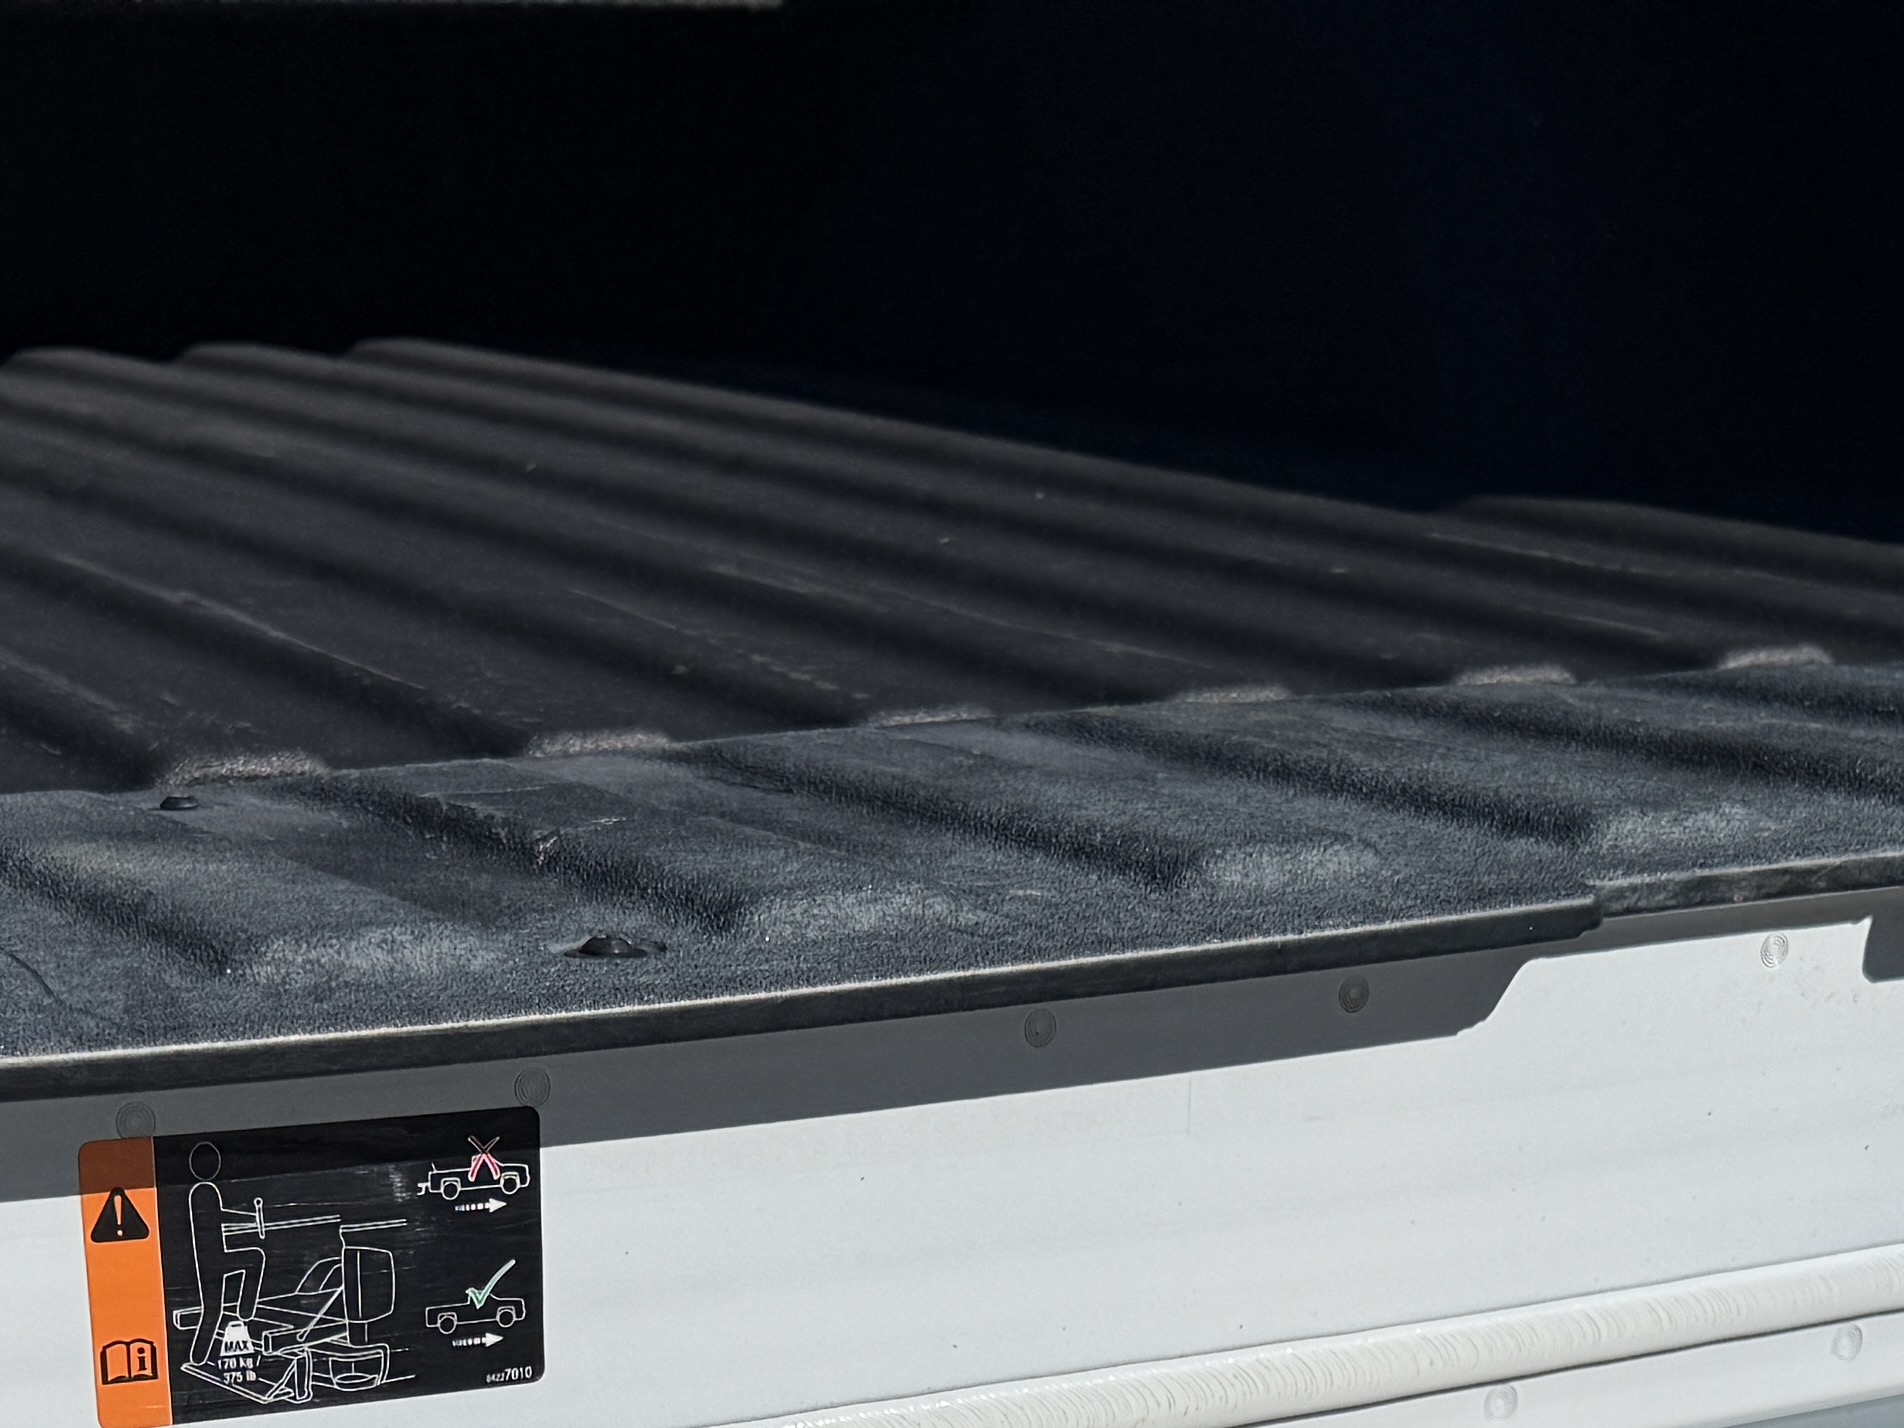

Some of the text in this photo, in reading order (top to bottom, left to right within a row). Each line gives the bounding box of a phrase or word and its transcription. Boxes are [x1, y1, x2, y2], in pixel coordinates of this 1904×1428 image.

[224, 1340, 250, 1353] MAX
[217, 1357, 237, 1370] 170
[223, 1369, 257, 1385] 375 lb
